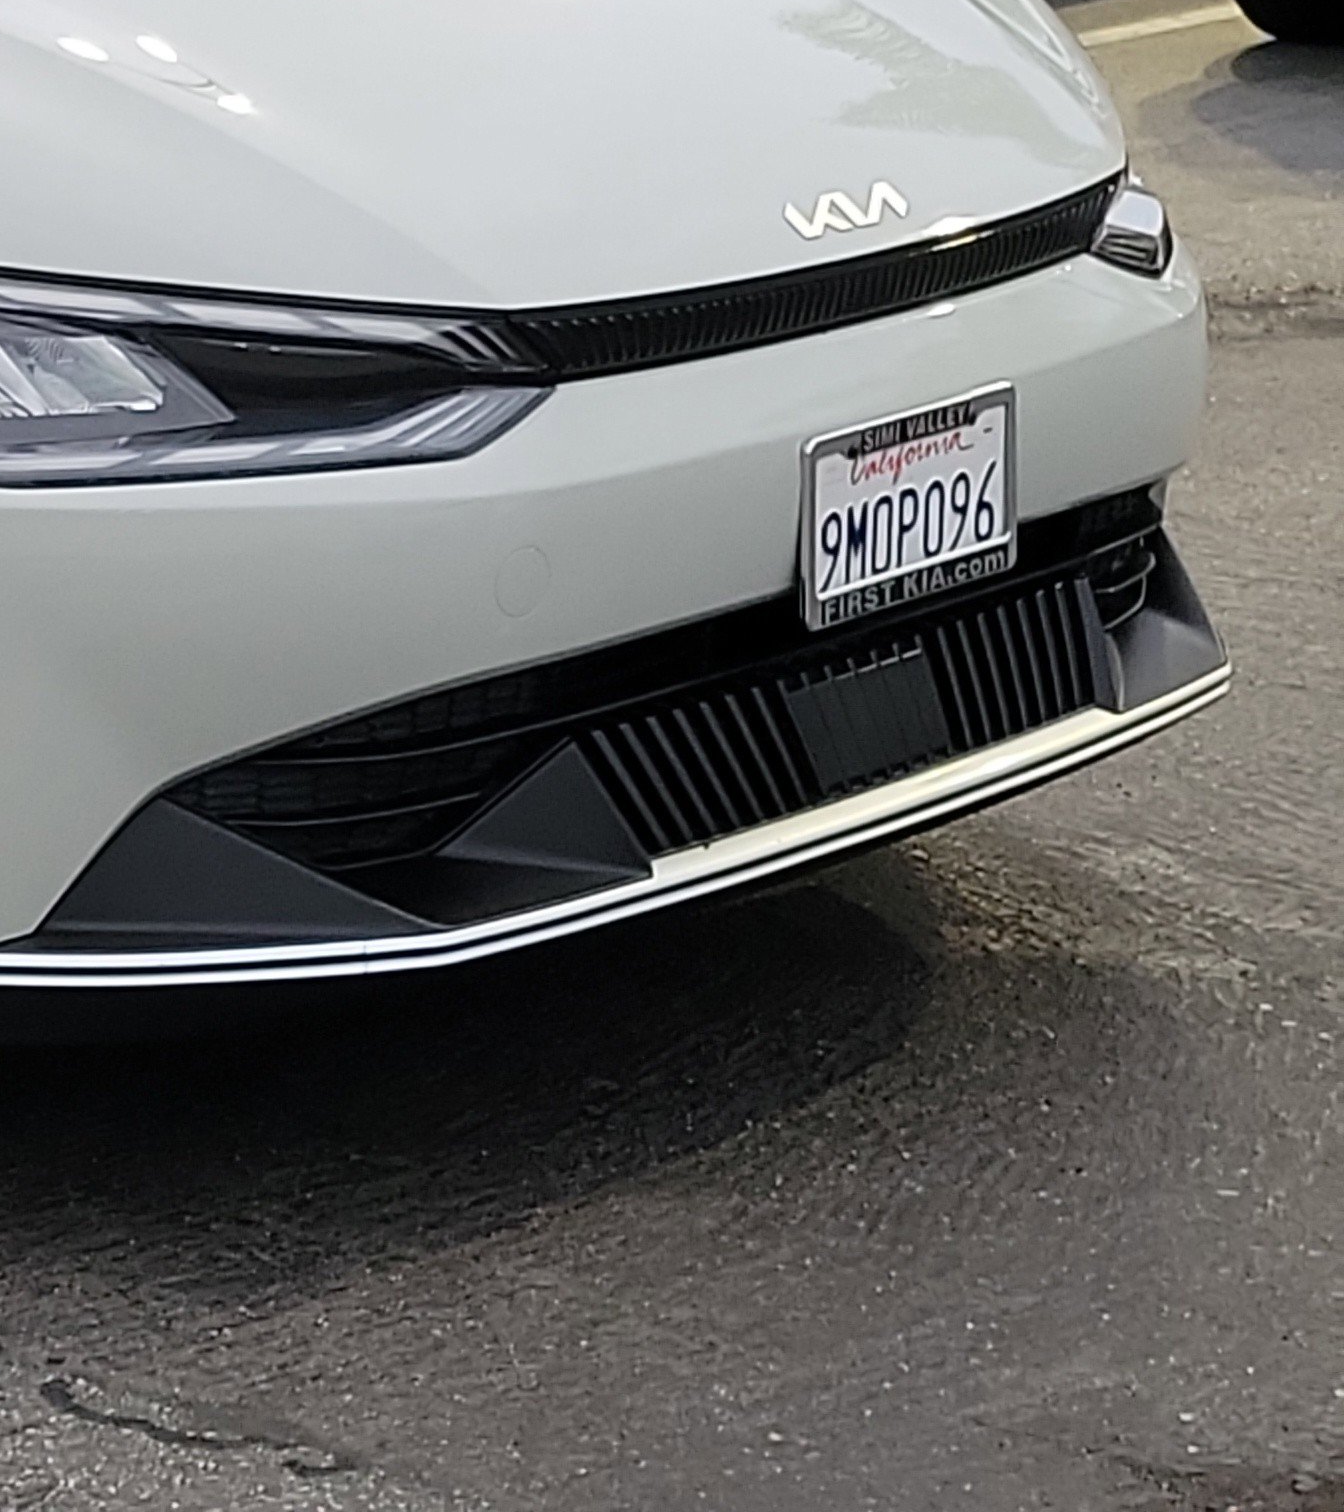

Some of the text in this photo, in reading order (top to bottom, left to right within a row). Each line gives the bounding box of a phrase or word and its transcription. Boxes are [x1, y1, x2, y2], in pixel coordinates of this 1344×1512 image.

[782, 181, 908, 239] KIA
[863, 403, 969, 452] SIMI VALLEY
[850, 431, 974, 486] California
[824, 549, 1007, 625] FIRST KIA.com
